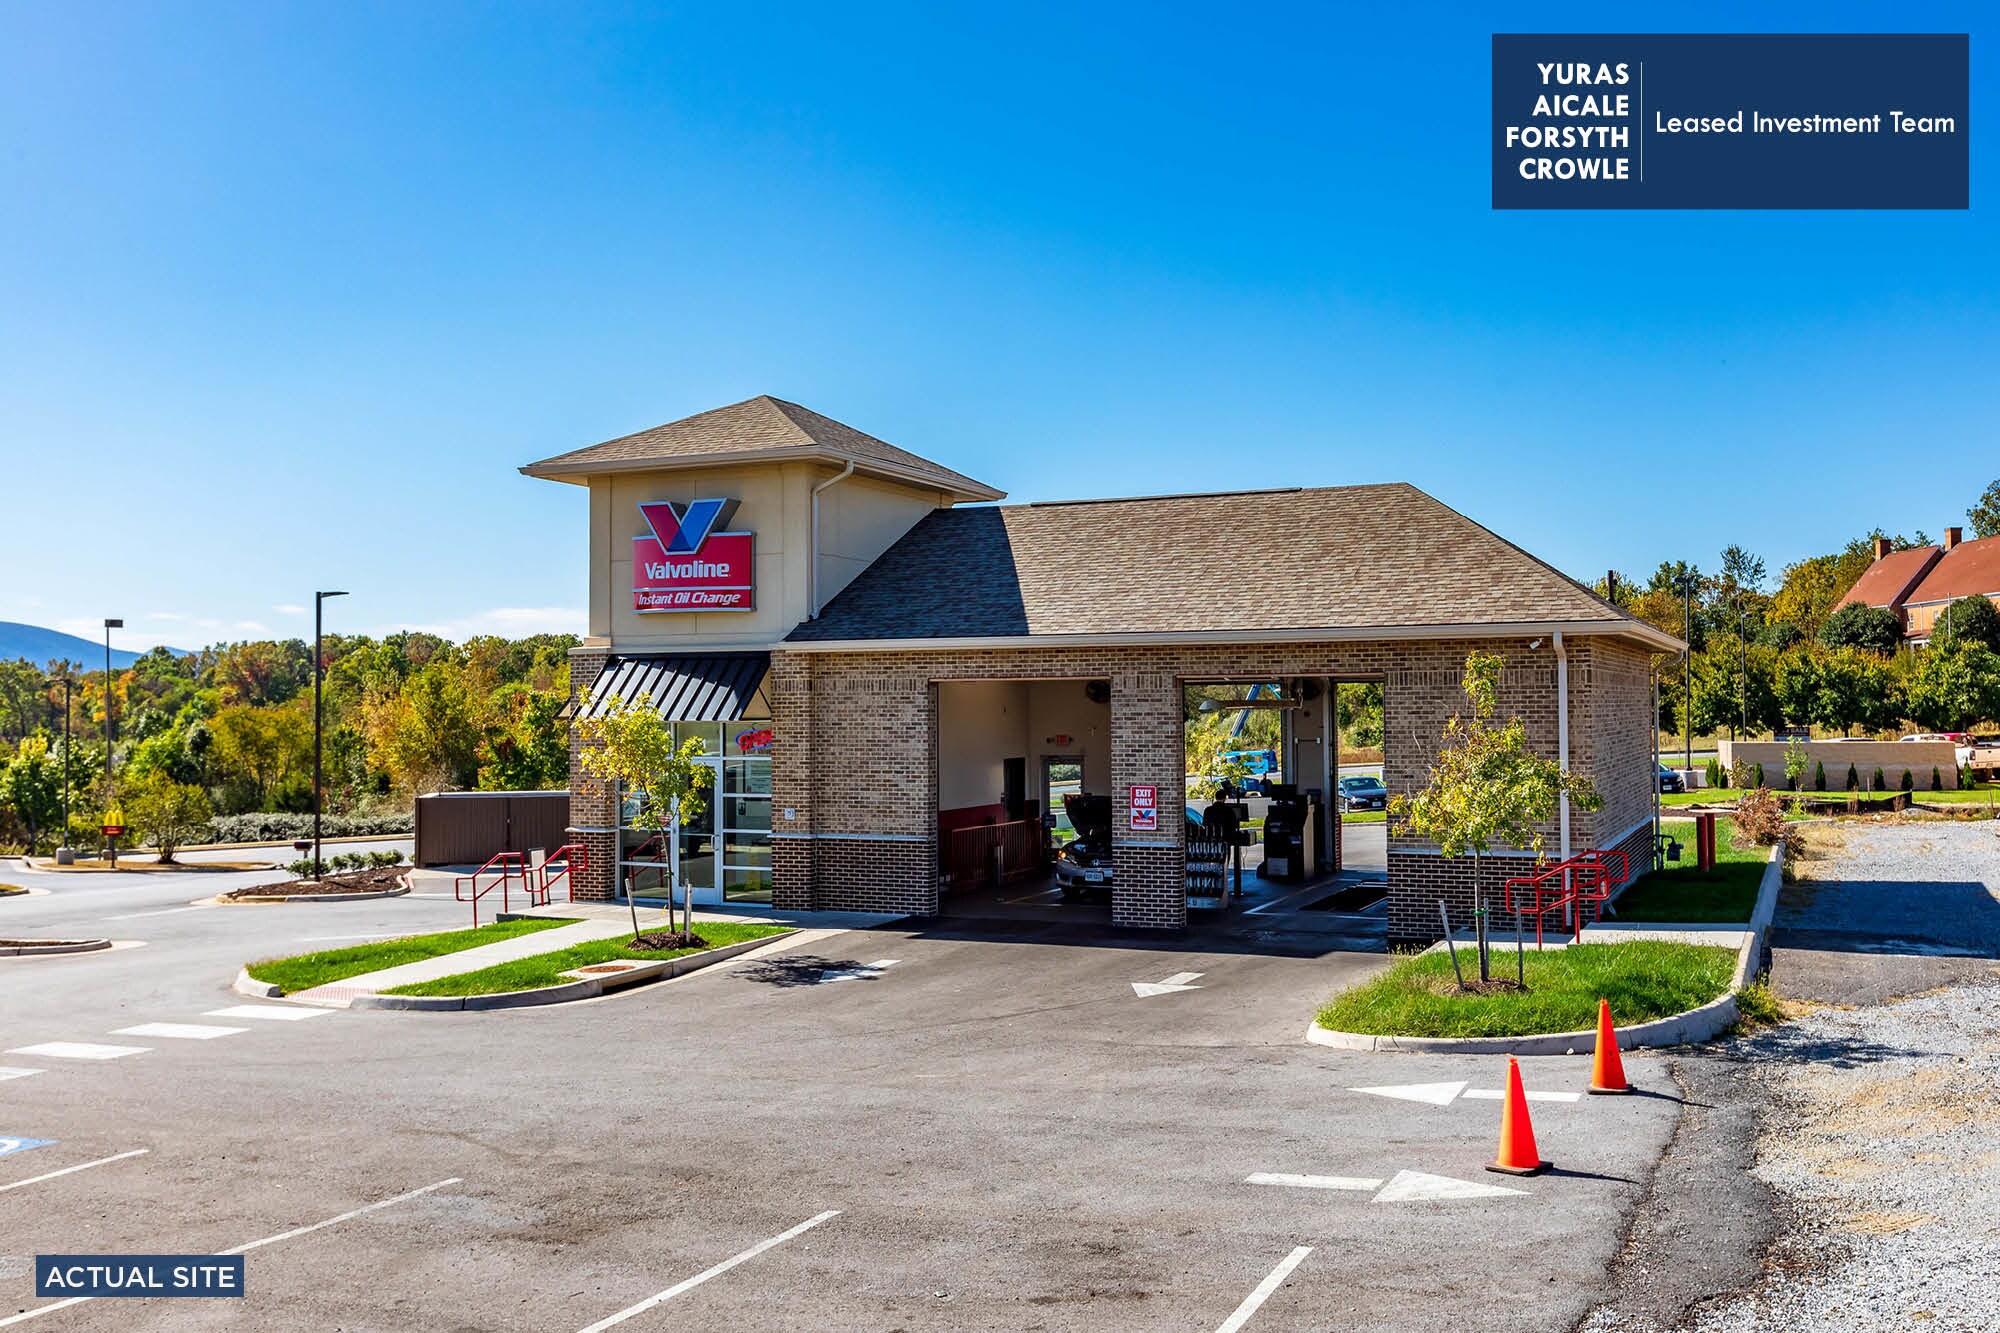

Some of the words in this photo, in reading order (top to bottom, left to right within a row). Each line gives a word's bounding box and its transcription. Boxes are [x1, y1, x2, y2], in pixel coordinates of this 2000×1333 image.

[644, 560, 730, 580] Valvoline
[638, 593, 673, 605] Instant
[674, 592, 691, 604] Oil
[691, 592, 742, 605] Change
[1135, 789, 1152, 797] EXIT
[1134, 798, 1153, 806] ONLY
